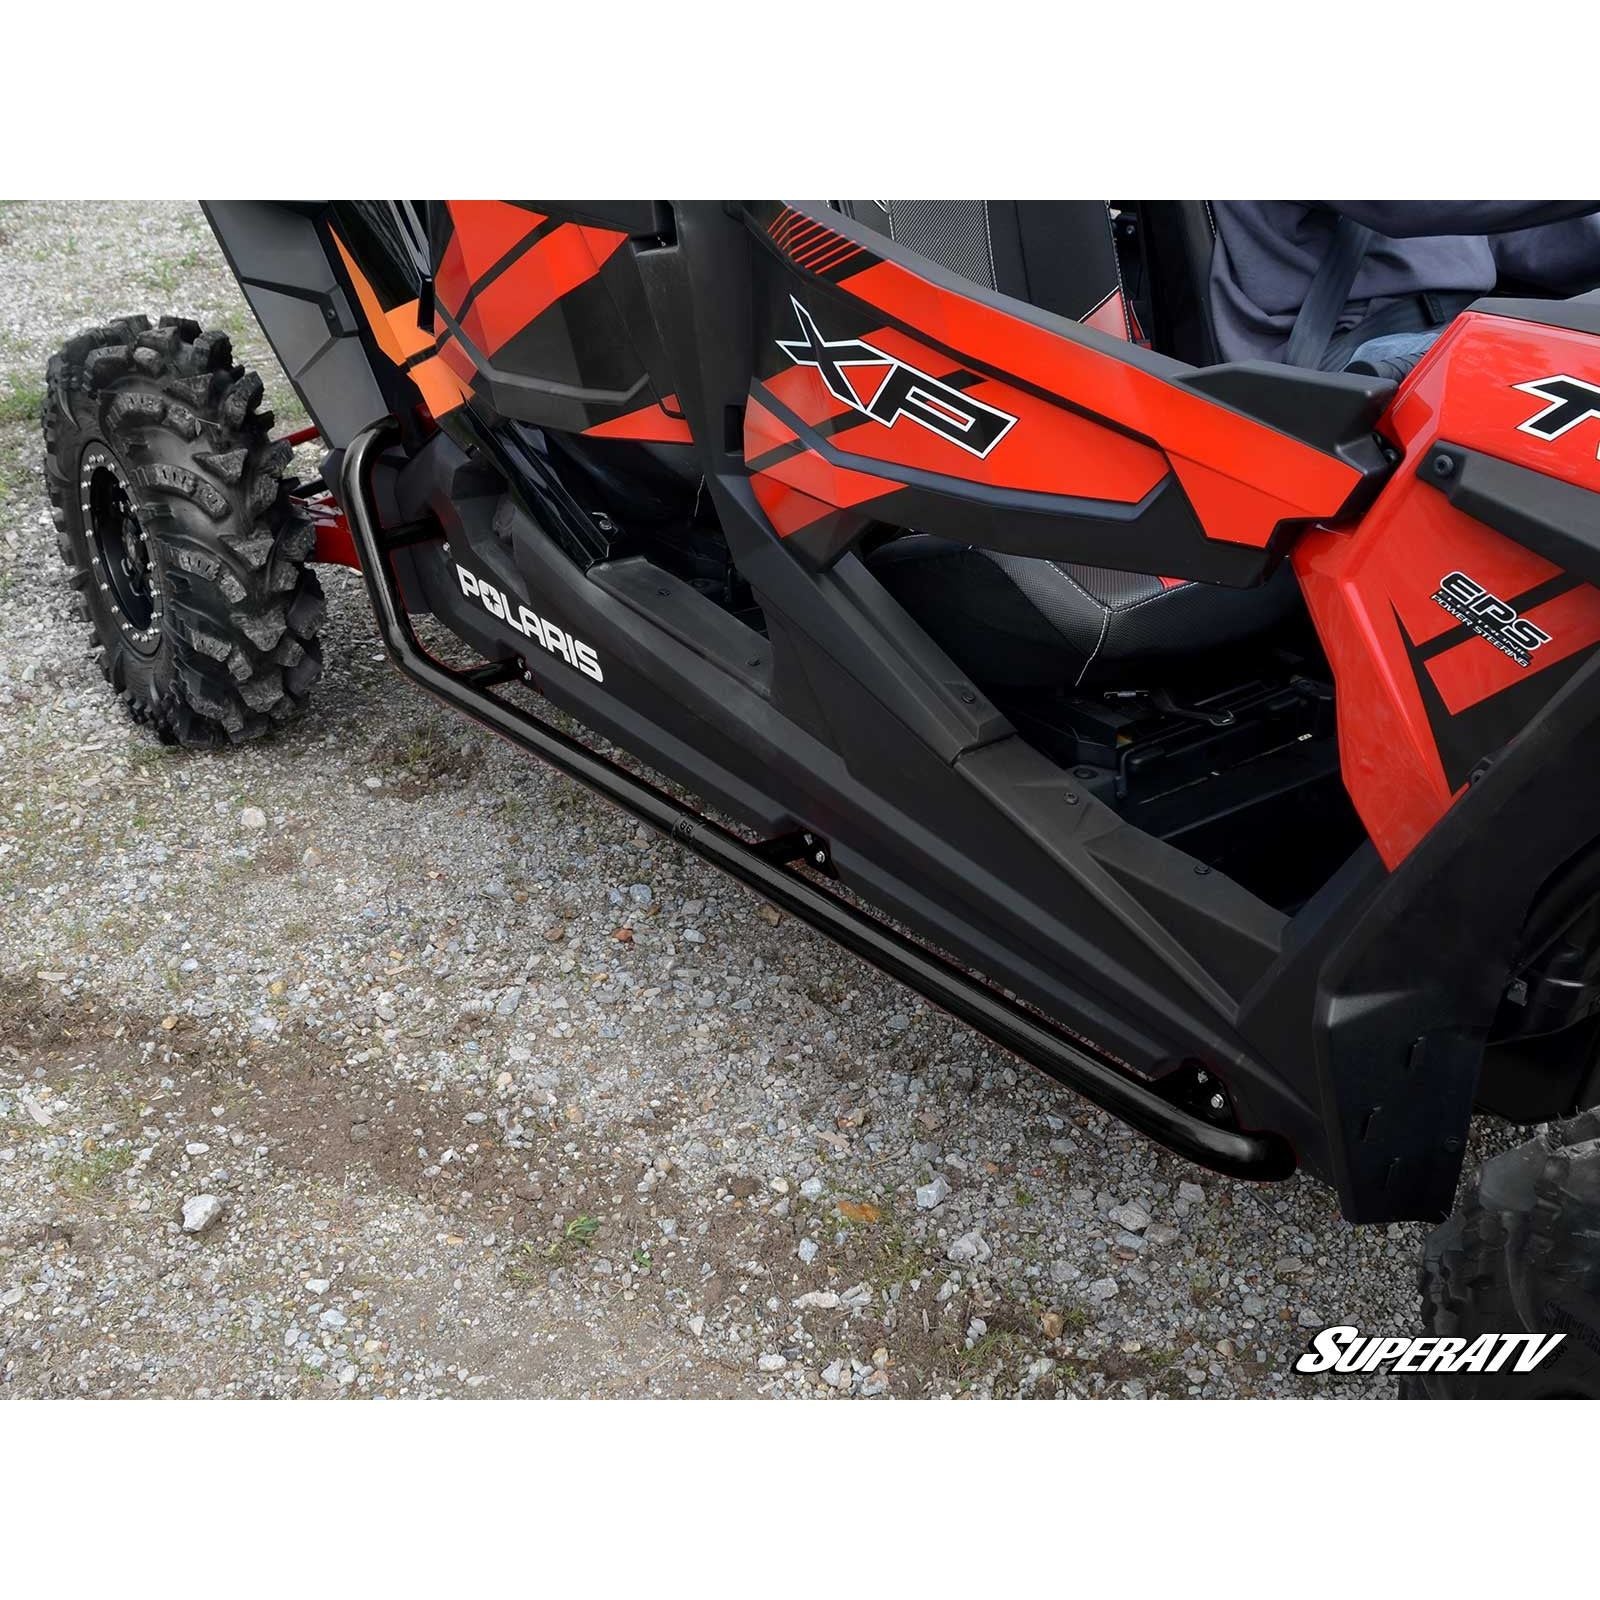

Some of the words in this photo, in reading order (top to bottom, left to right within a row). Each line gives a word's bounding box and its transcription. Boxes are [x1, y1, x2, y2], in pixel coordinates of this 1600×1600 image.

[775, 293, 1020, 461] XP
[1510, 373, 1600, 461] T
[455, 563, 604, 683] POLARIS
[1430, 594, 1473, 627] POWER
[1473, 625, 1530, 668] STEERING
[1439, 570, 1553, 651] EPS
